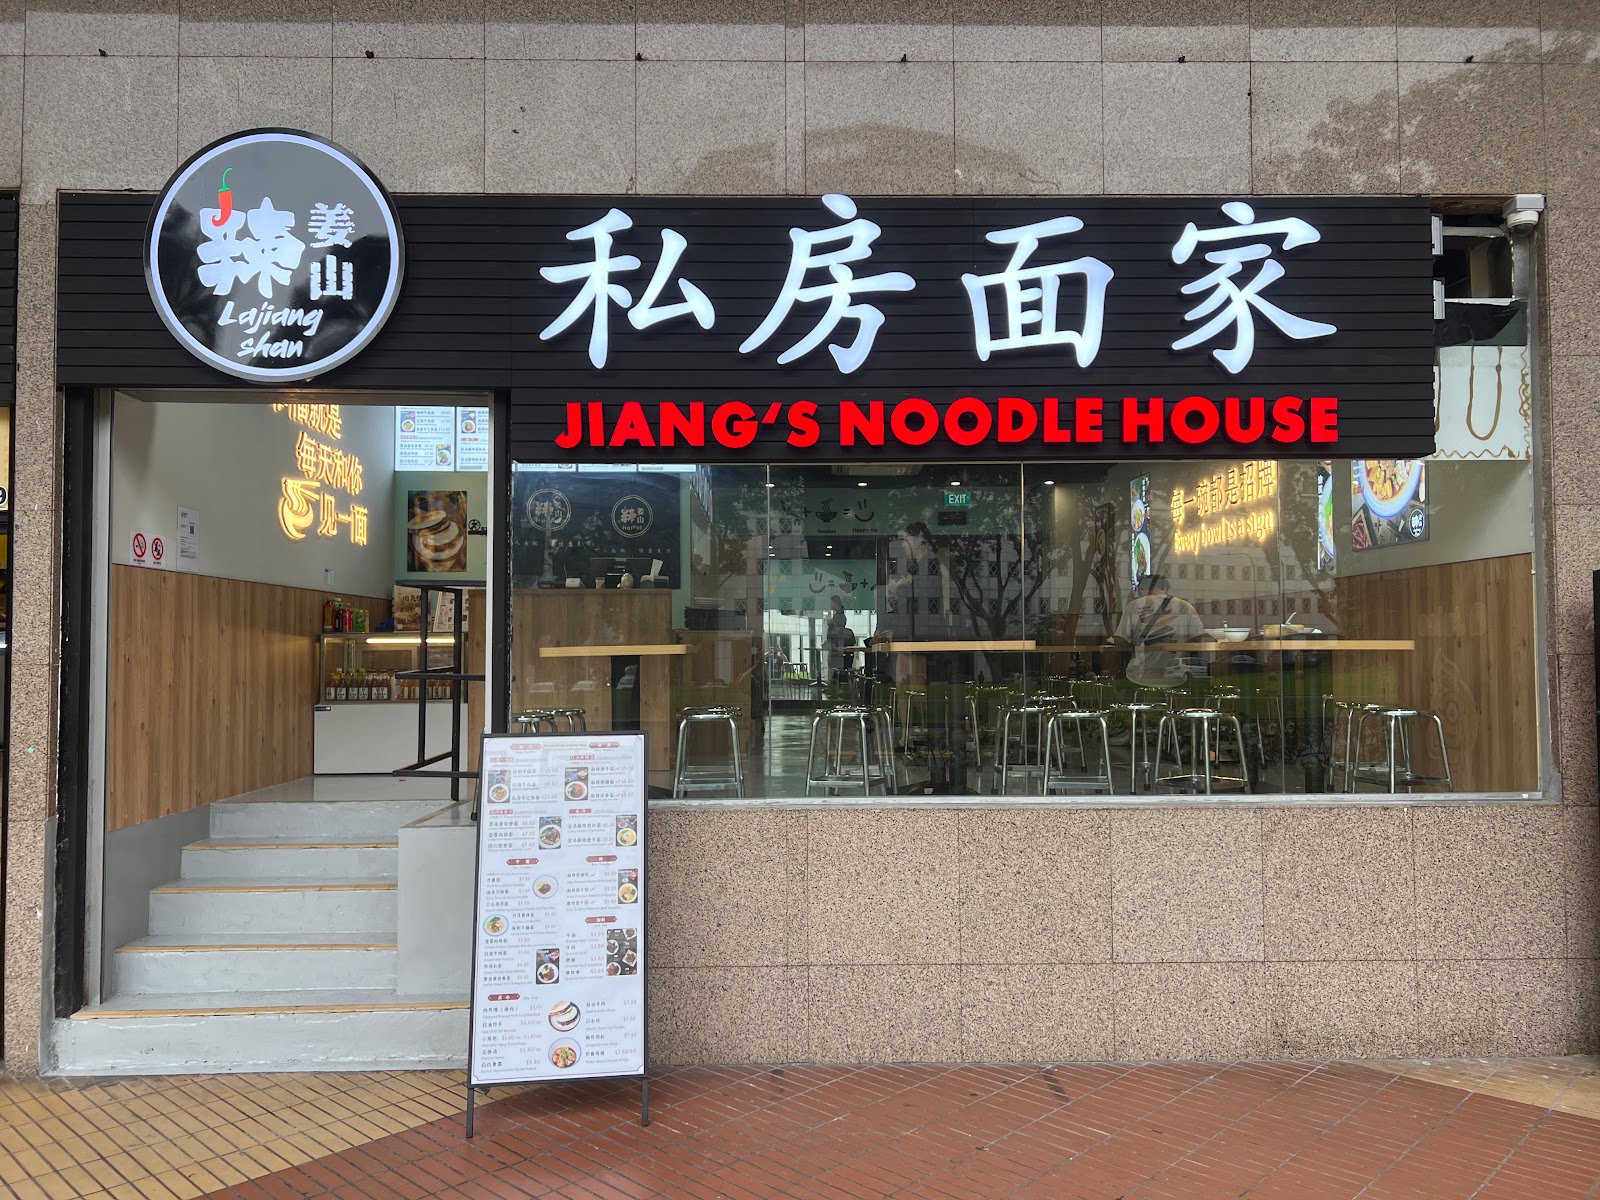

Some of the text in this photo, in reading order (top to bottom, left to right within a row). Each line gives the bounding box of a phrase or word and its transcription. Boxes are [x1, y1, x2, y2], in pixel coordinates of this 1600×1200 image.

[539, 193, 1337, 375] 私房面家
[217, 300, 324, 337] Lajiang
[236, 330, 304, 359] shan
[839, 397, 1103, 446] NOODLE
[1123, 395, 1339, 444] HOUSE
[296, 431, 363, 495] 每天和你
[317, 491, 369, 546] 见一面
[947, 493, 968, 505] EXIT
[1174, 531, 1201, 556] Every
[1200, 516, 1226, 548] bowl
[1237, 517, 1246, 540] a
[1245, 509, 1275, 542] sign
